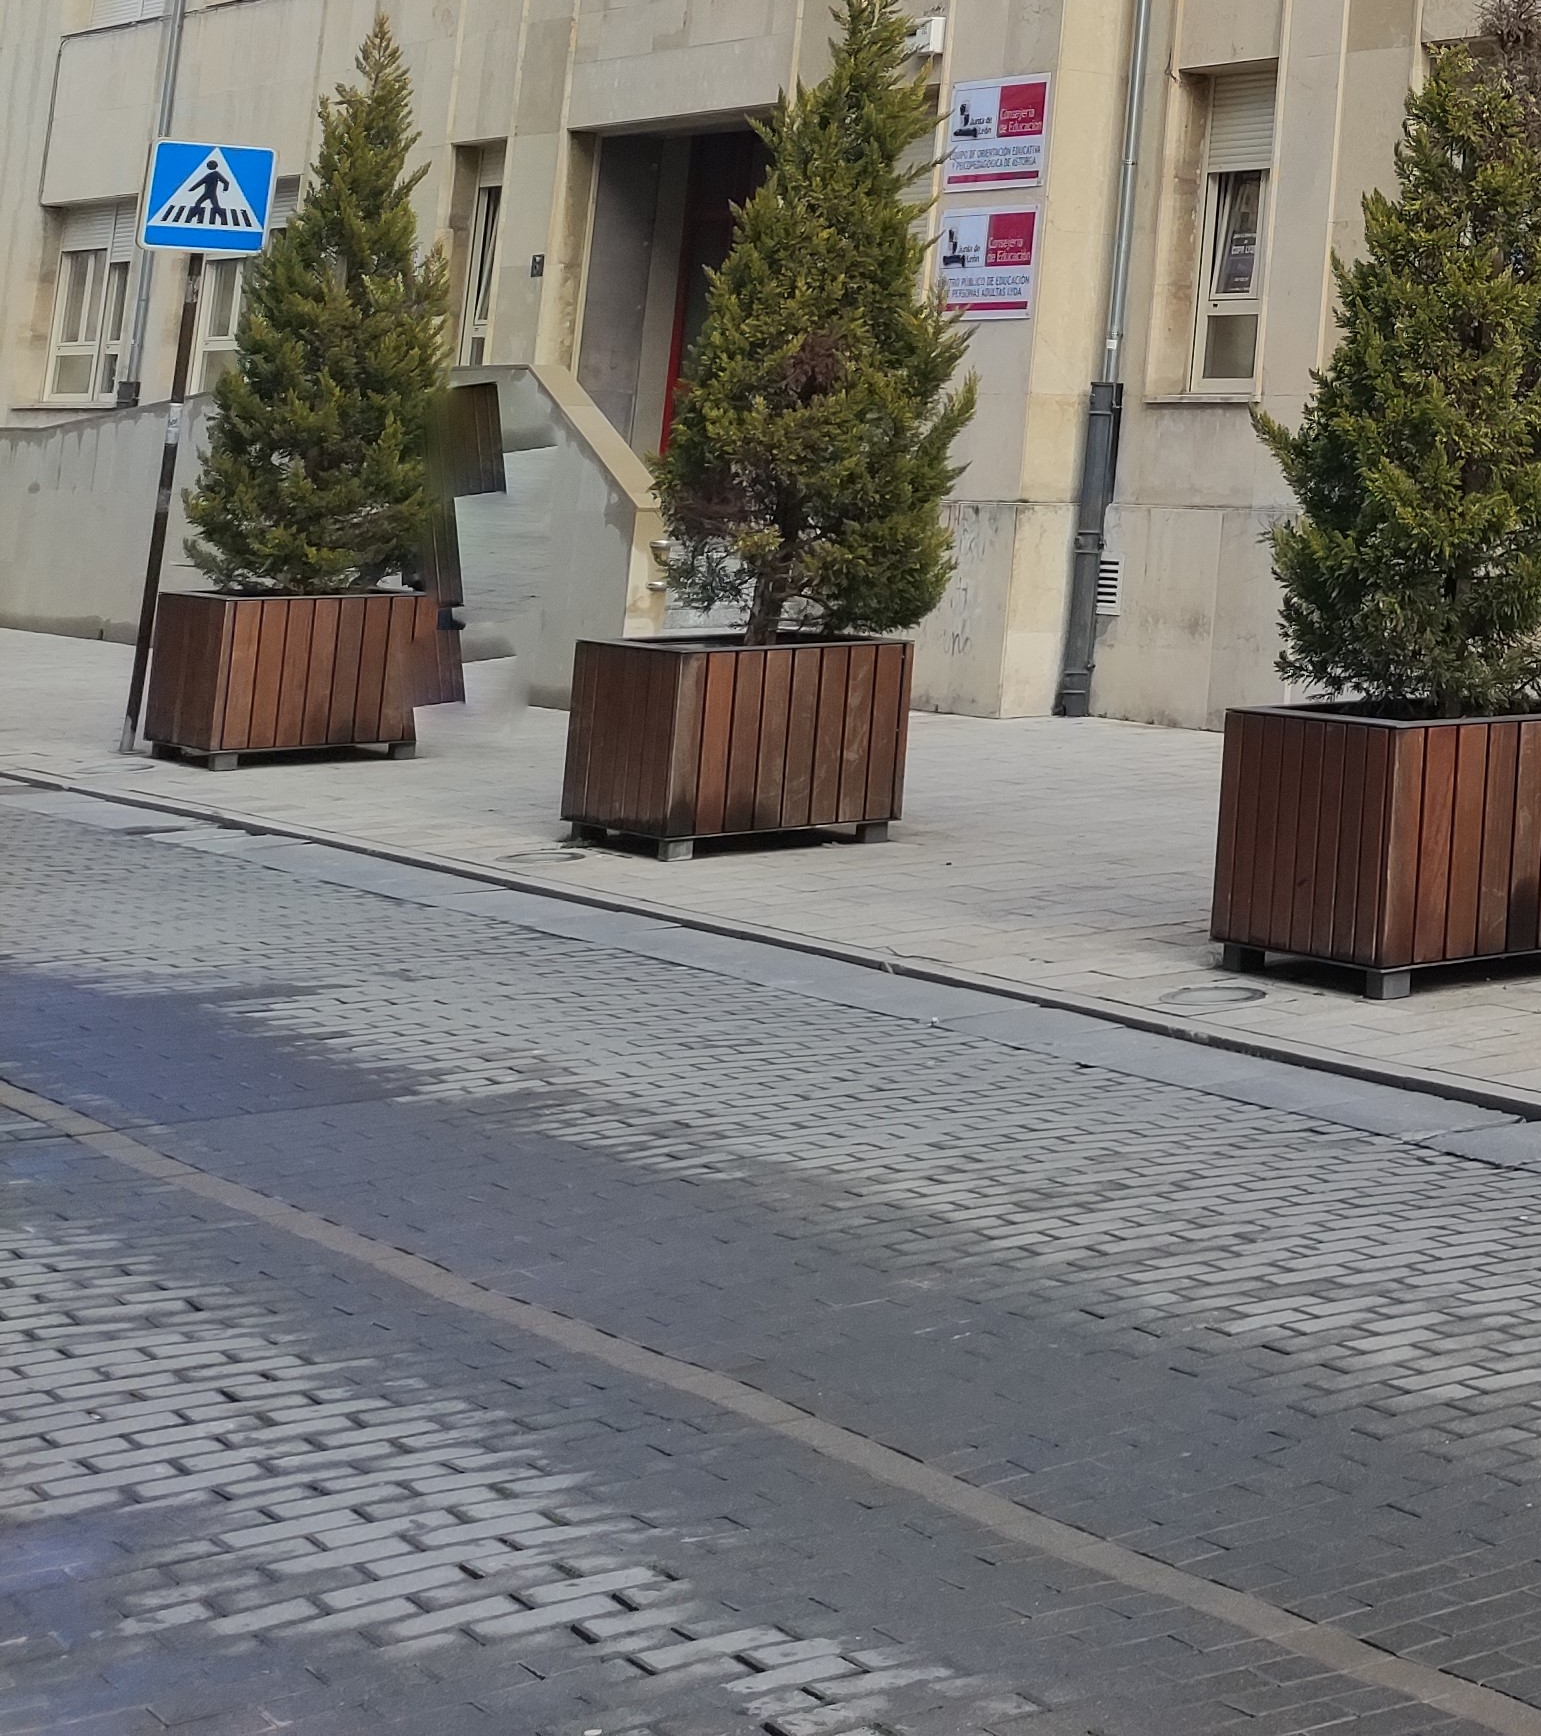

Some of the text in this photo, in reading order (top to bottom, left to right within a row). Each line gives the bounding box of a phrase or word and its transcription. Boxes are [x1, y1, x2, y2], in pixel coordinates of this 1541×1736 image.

[1008, 120, 1042, 132] Educación
[987, 249, 1031, 263] de Educación
